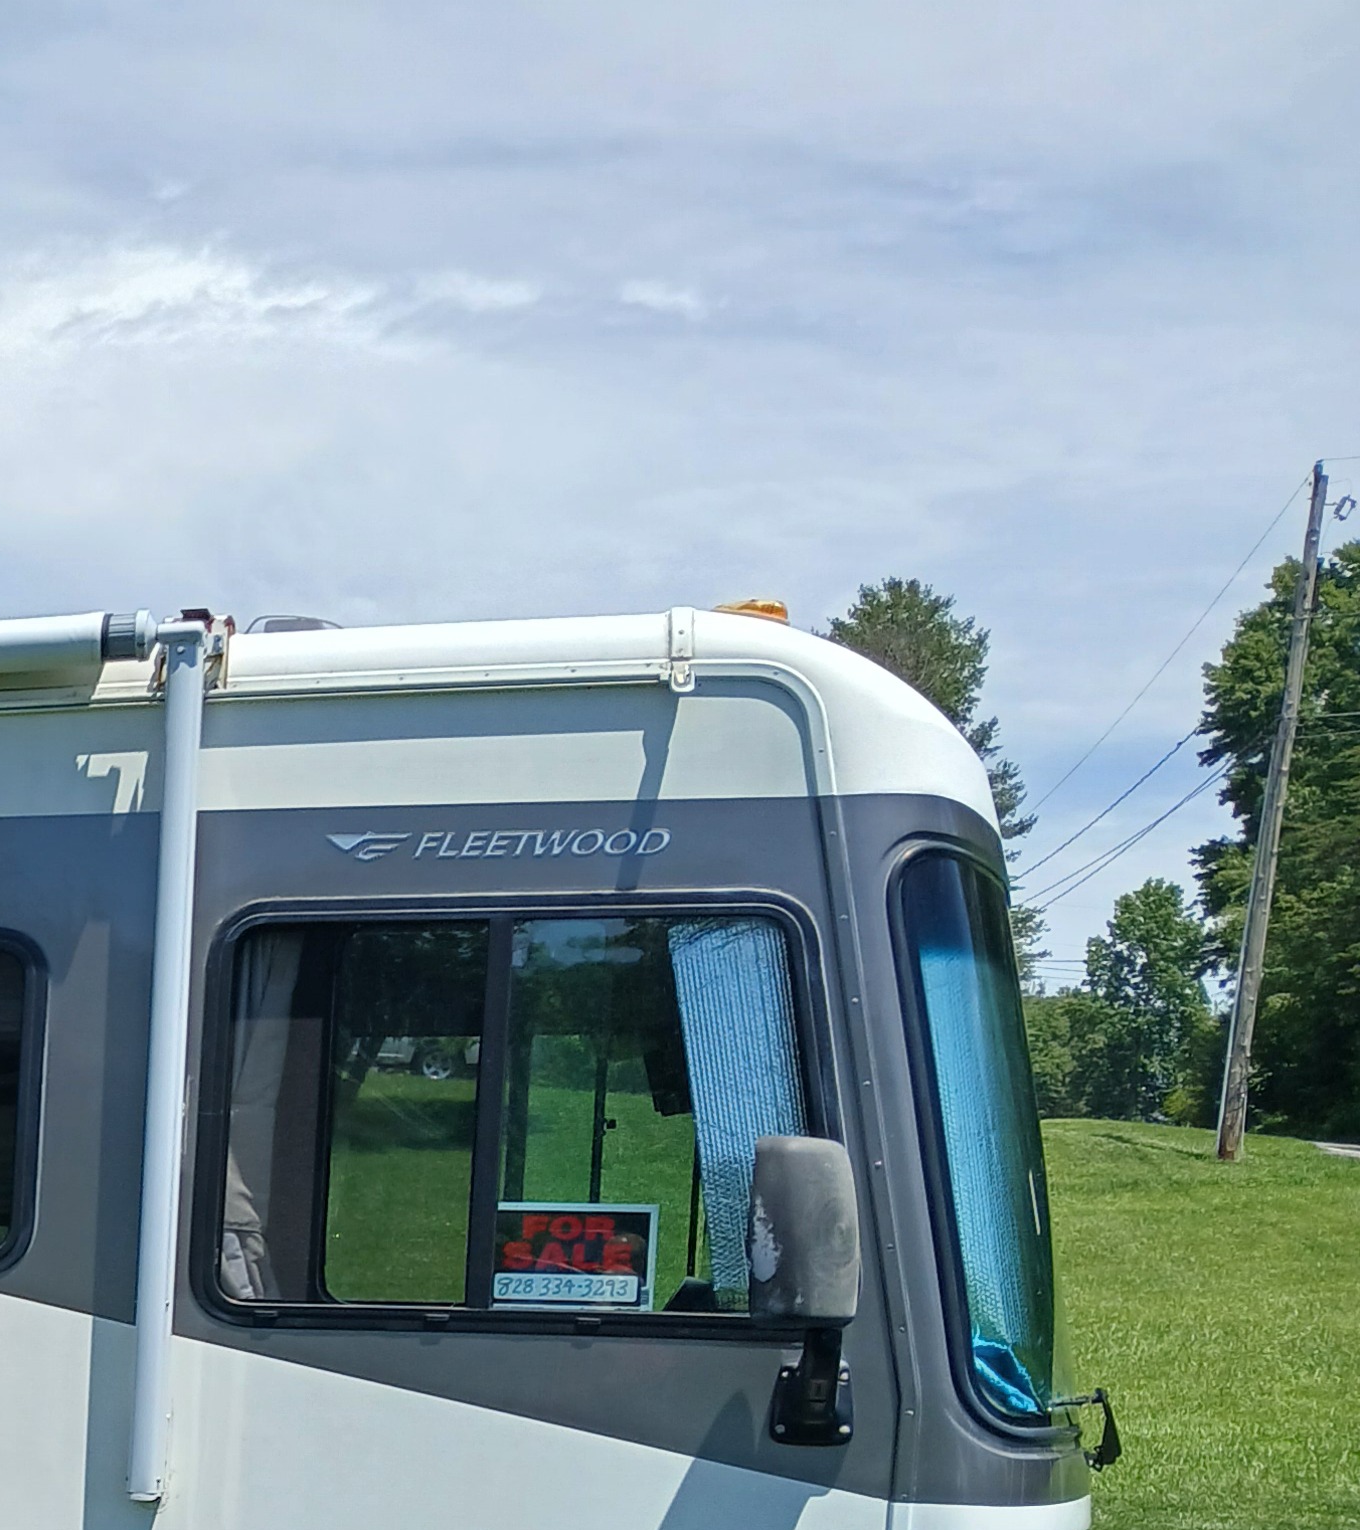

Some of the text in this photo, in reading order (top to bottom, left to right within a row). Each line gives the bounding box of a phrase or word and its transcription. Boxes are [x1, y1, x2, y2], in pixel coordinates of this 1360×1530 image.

[412, 828, 672, 860] FLEETWOOD
[522, 1214, 616, 1241] FOR
[502, 1241, 634, 1272] SALE
[496, 1276, 534, 1297] 828
